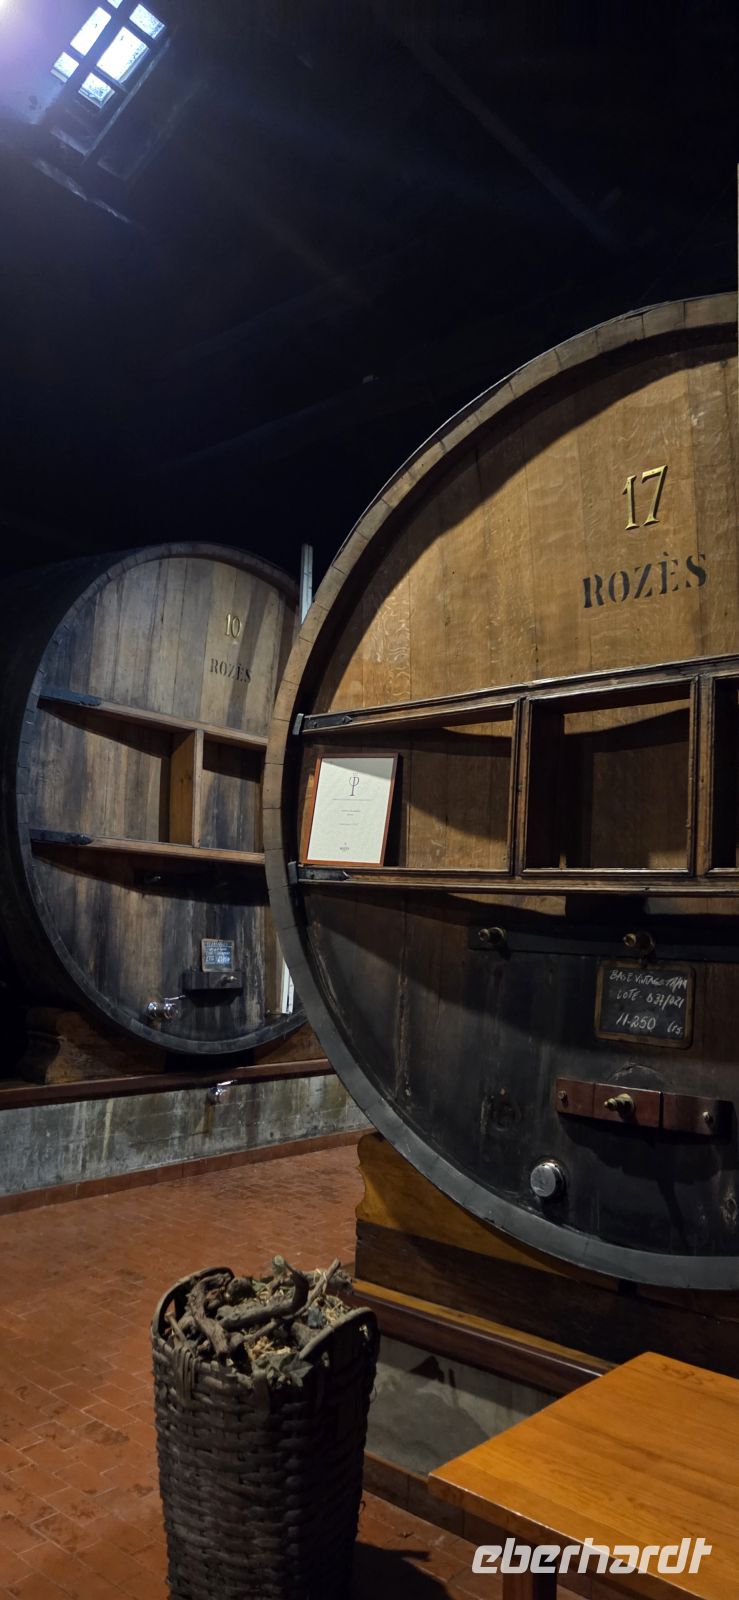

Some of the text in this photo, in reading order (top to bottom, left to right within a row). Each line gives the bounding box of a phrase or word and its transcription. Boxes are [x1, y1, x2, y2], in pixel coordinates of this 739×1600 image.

[622, 464, 668, 530] 17
[582, 551, 707, 608] ROZÈS
[225, 613, 242, 639] 10
